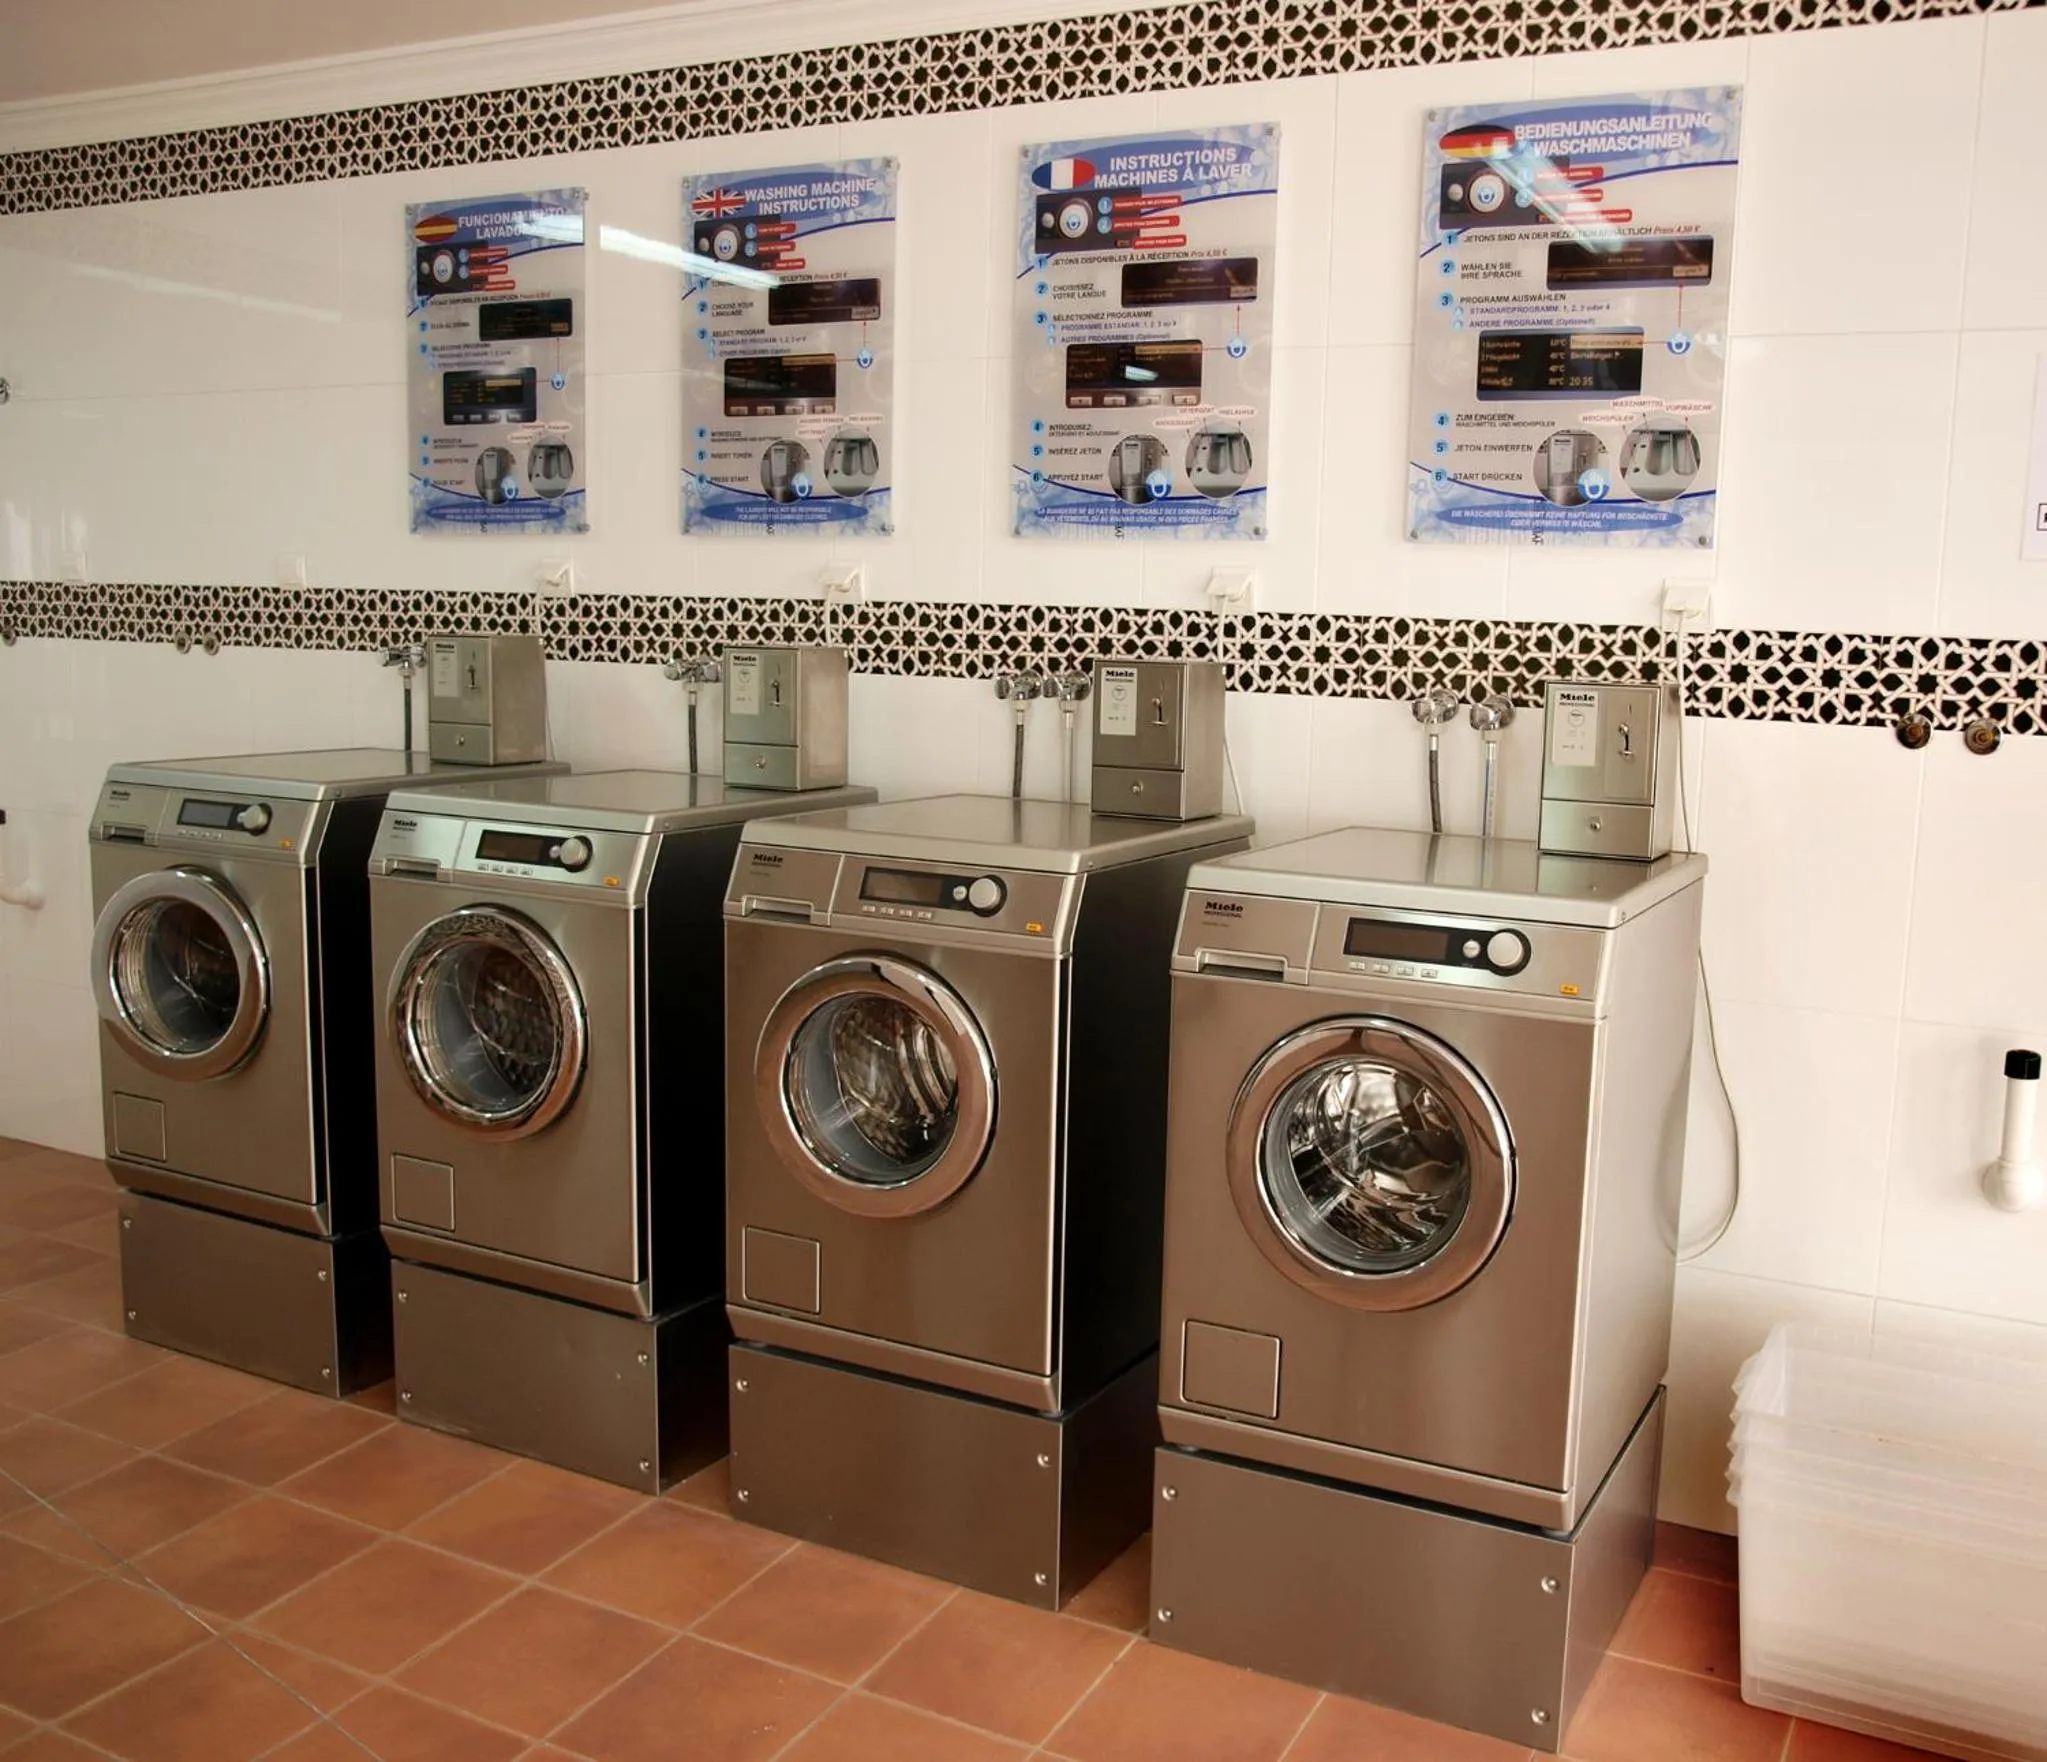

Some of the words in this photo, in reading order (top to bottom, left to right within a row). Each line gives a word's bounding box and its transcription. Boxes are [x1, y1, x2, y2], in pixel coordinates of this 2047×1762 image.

[1514, 112, 1712, 140] BEDIENUNGSANLEITUNG
[1532, 132, 1692, 158] WASCHMASCHINEN
[1109, 148, 1238, 171] INSTRUCTIONS
[1094, 171, 1178, 190] MACHINES
[1198, 162, 1252, 180] LAVER
[743, 185, 808, 205] WASHING
[811, 178, 876, 199] MACHINE
[758, 194, 860, 216] INSTRUCTIONS
[1464, 233, 1496, 244] JETONS
[1497, 232, 1517, 243] SIND
[1519, 231, 1531, 241] AN
[1532, 229, 1549, 240] DER
[1459, 295, 1509, 305] PROGRAMM
[1454, 444, 1482, 453] JETON
[1105, 670, 1136, 679] Miele
[1559, 692, 1596, 702] Miele
[753, 853, 784, 863] Miele
[1205, 901, 1245, 912] Miele
